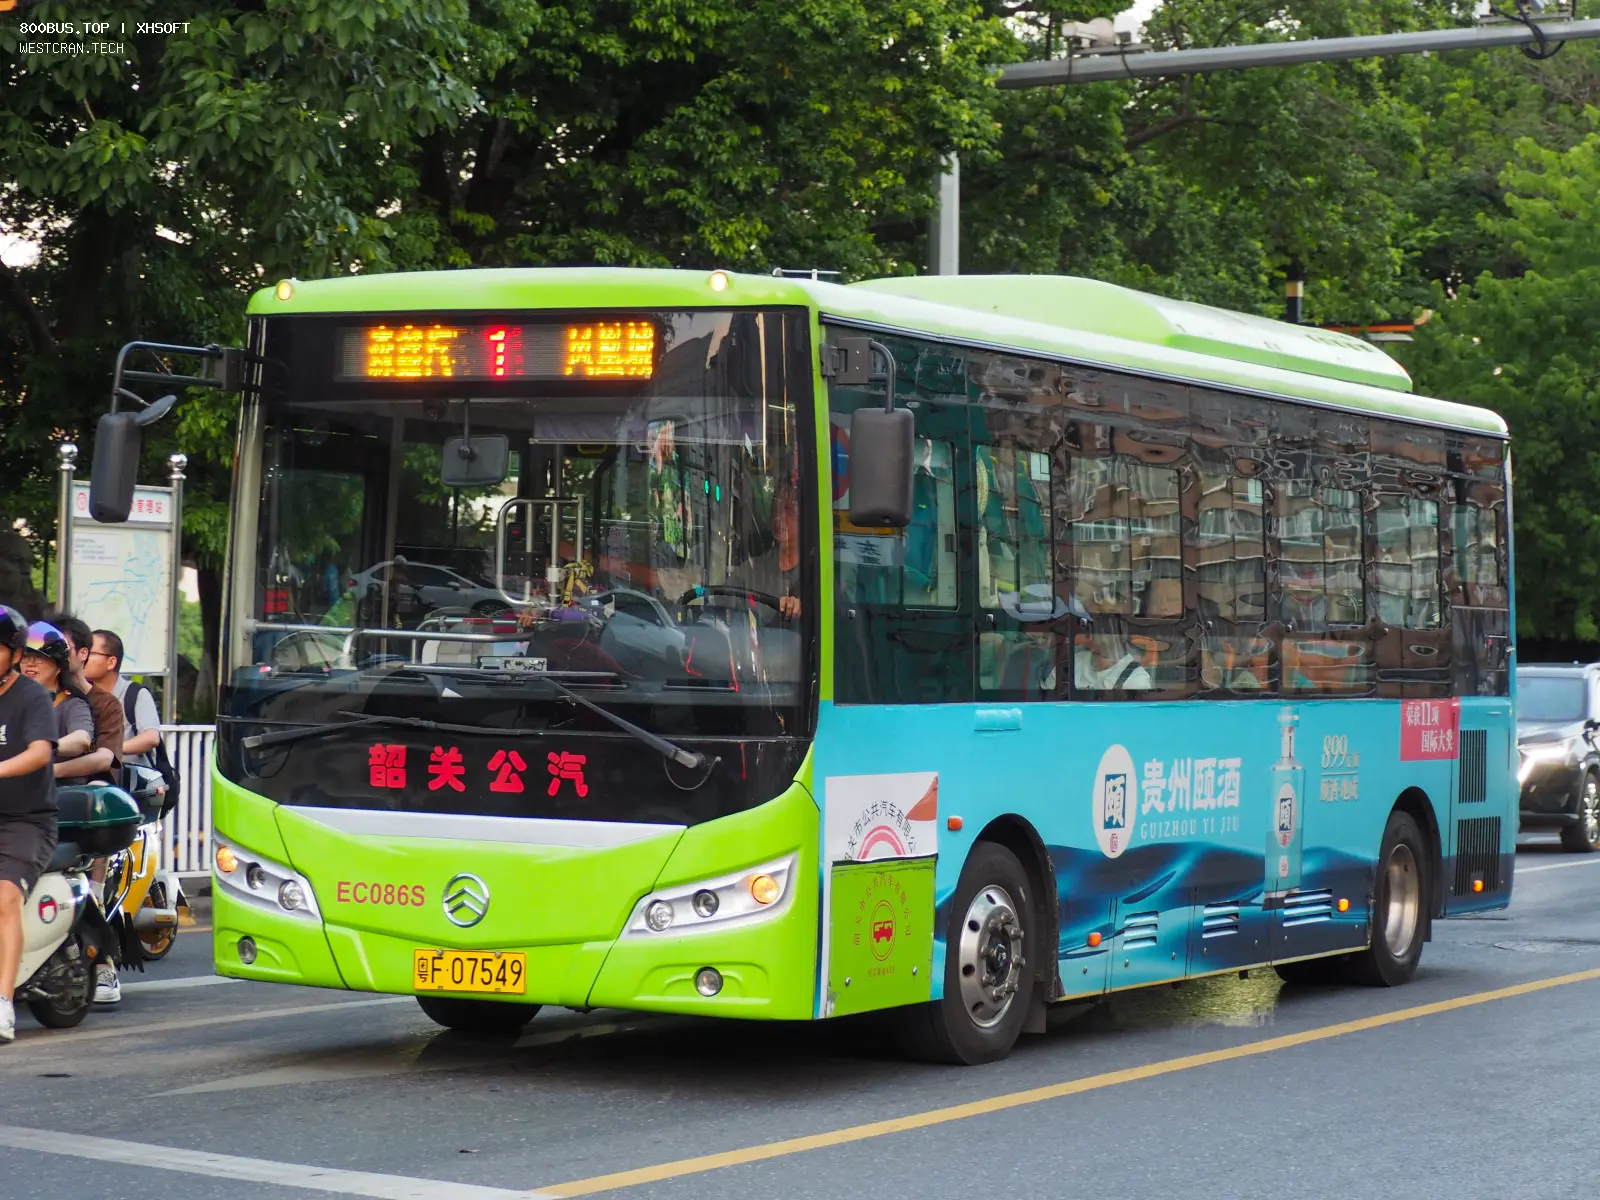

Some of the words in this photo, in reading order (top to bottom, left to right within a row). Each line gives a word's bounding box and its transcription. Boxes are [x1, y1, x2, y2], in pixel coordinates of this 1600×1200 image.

[488, 329, 506, 376] 1
[1406, 702, 1440, 727] 荣获11项
[1421, 728, 1454, 753] 国际大奖
[367, 743, 590, 798] 韶关公汽
[1141, 756, 1242, 815] 贵州颐酒
[1140, 819, 1197, 840] GUIZHOU
[1203, 817, 1215, 834] YI
[1220, 815, 1239, 835] JIU
[336, 880, 426, 907] EC086S
